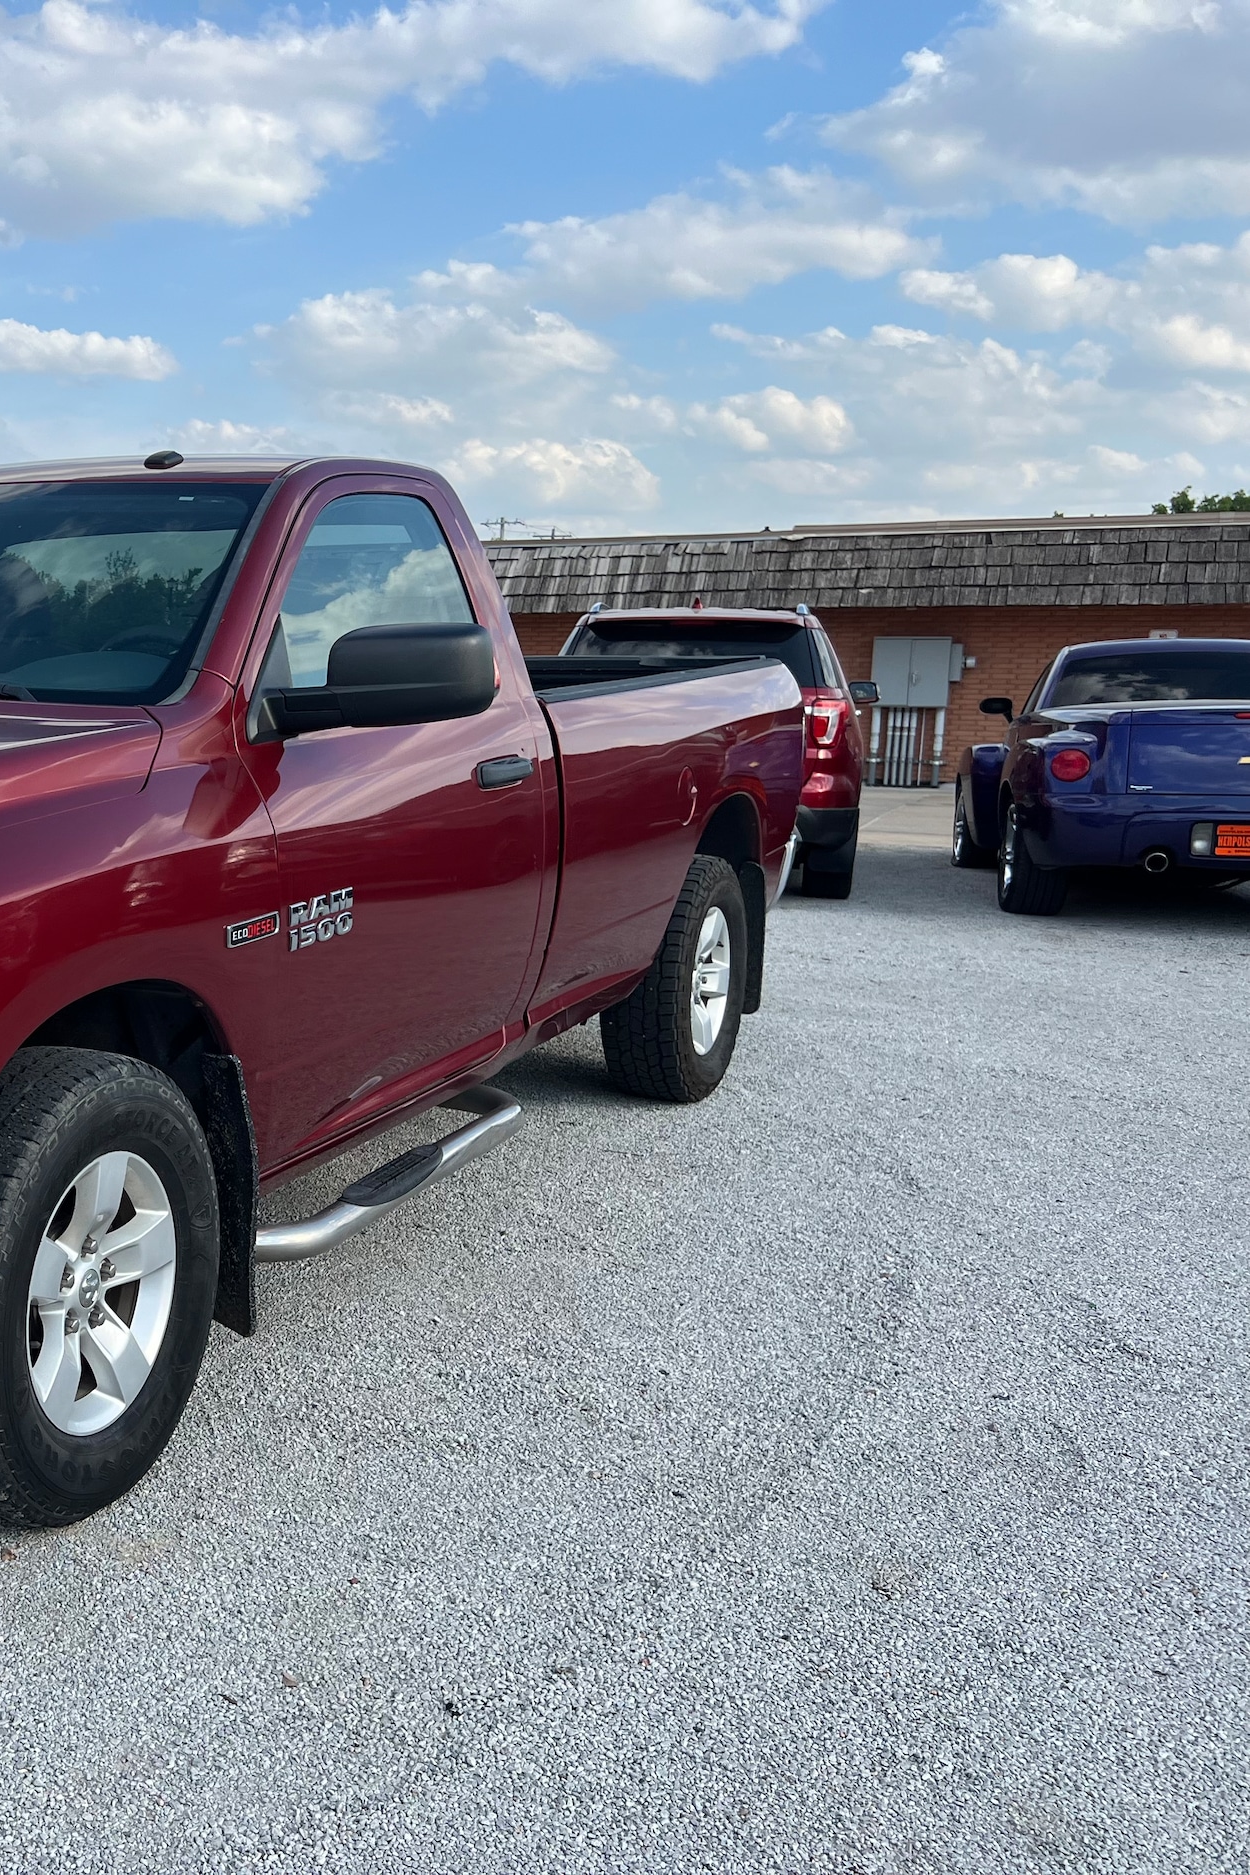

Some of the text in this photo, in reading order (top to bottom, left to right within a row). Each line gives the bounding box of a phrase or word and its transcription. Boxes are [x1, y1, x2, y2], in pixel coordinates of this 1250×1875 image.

[288, 886, 354, 928] RAM
[231, 917, 276, 942] ECODIESEL
[288, 911, 355, 953] 1500
